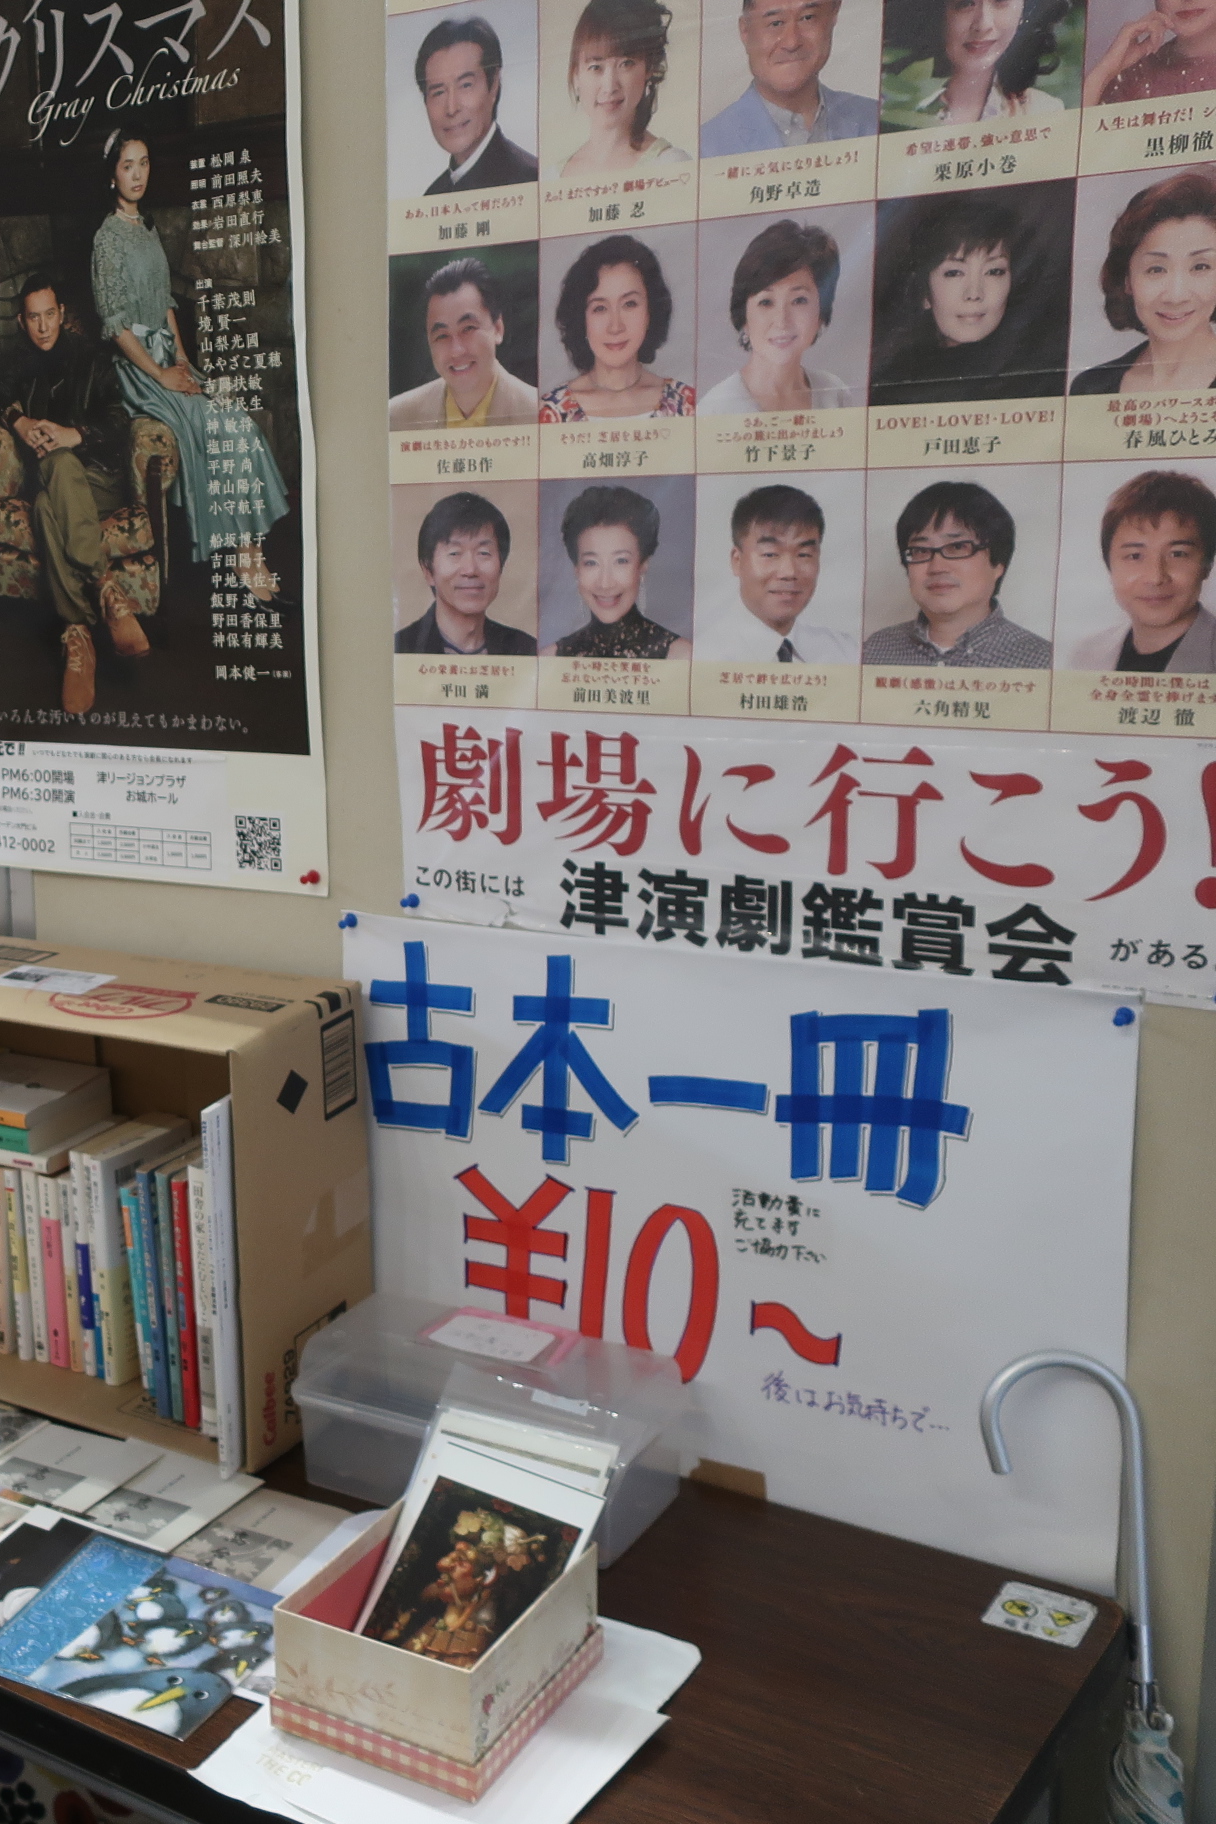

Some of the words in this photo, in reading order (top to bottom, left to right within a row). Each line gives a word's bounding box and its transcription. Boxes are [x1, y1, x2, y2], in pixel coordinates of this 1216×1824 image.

[27, 88, 94, 147] Gray
[105, 47, 240, 112] Christmas
[1095, 107, 1193, 132] 人生は舞台だ!
[906, 127, 1052, 157] 希望と連帯、強い意思で
[1144, 130, 1214, 158] 黒柳徹
[240, 148, 251, 164] 泉
[211, 167, 263, 189] 前田照夫
[935, 155, 1018, 182] 栗原小巻
[211, 189, 264, 209] 西原梨恵
[750, 179, 821, 204] 角野卓造
[404, 194, 525, 220] ああ、日本人って何だろう?
[589, 204, 621, 223] 加藤
[630, 202, 646, 218] 忍
[212, 210, 265, 231] 岩田直行
[229, 227, 282, 249] 深川絵美
[438, 222, 469, 241] 加藤
[476, 220, 491, 237] 剛
[197, 289, 256, 312] 千葉茂則
[198, 316, 214, 333] 境
[218, 313, 247, 332] 賢一
[202, 350, 283, 374] みやざこ夏穂
[206, 395, 264, 415] 天津民生
[744, 414, 816, 428] さあ、ご一緒に
[560, 433, 591, 445] そうだ!
[717, 426, 844, 443] こころの旅に出かけましょう
[1125, 428, 1216, 449] 春風ひとみ
[206, 436, 265, 455] 塩田泰久
[745, 443, 816, 462] 竹下景子
[923, 435, 1002, 456] 戸田恵子
[207, 459, 236, 475] 平野
[241, 457, 253, 474] 尚
[436, 456, 494, 475] 佐藤B作
[582, 450, 649, 469] 高畑淳子
[207, 477, 265, 495] 横山陽介
[208, 499, 266, 516] 小守航平
[209, 532, 267, 549] 船坂博子
[211, 553, 267, 569] 吉田陽子
[211, 572, 281, 589] 中地美佐子
[210, 592, 238, 609] 飯野
[212, 613, 283, 629] 野田香保里
[212, 632, 284, 650] 神保有輝美
[215, 664, 270, 681] 岡本健一
[418, 664, 516, 676] 心の栄養にお芝居を!
[572, 660, 651, 672] 辛い時こそ笑顔を
[719, 671, 827, 686] 芝居で絆を広げよう!
[1100, 675, 1210, 689] その時間に僕らは
[440, 683, 468, 699] 平田
[474, 684, 490, 699] 満
[573, 687, 651, 705] 前田美波里
[741, 692, 808, 712] 村田雄浩
[914, 699, 992, 719] 六角精児
[1119, 706, 1161, 725] 渡辺
[1175, 708, 1195, 726] 徹
[1, 767, 75, 785] PM6:00開場
[96, 770, 186, 789] 津リージョンプラザ
[1, 786, 75, 804] PM6:30開演
[126, 790, 179, 805] お城ホール
[414, 866, 526, 898] この街には
[558, 858, 1078, 986] 津演劇鑑賞会
[1109, 938, 1216, 970] がある
[365, 940, 973, 1211] 古本一冊
[732, 1188, 822, 1217] 活動費に
[733, 1208, 801, 1236] 充てます
[735, 1237, 828, 1264] ご協力下さい
[262, 1371, 278, 1447] Calbee
